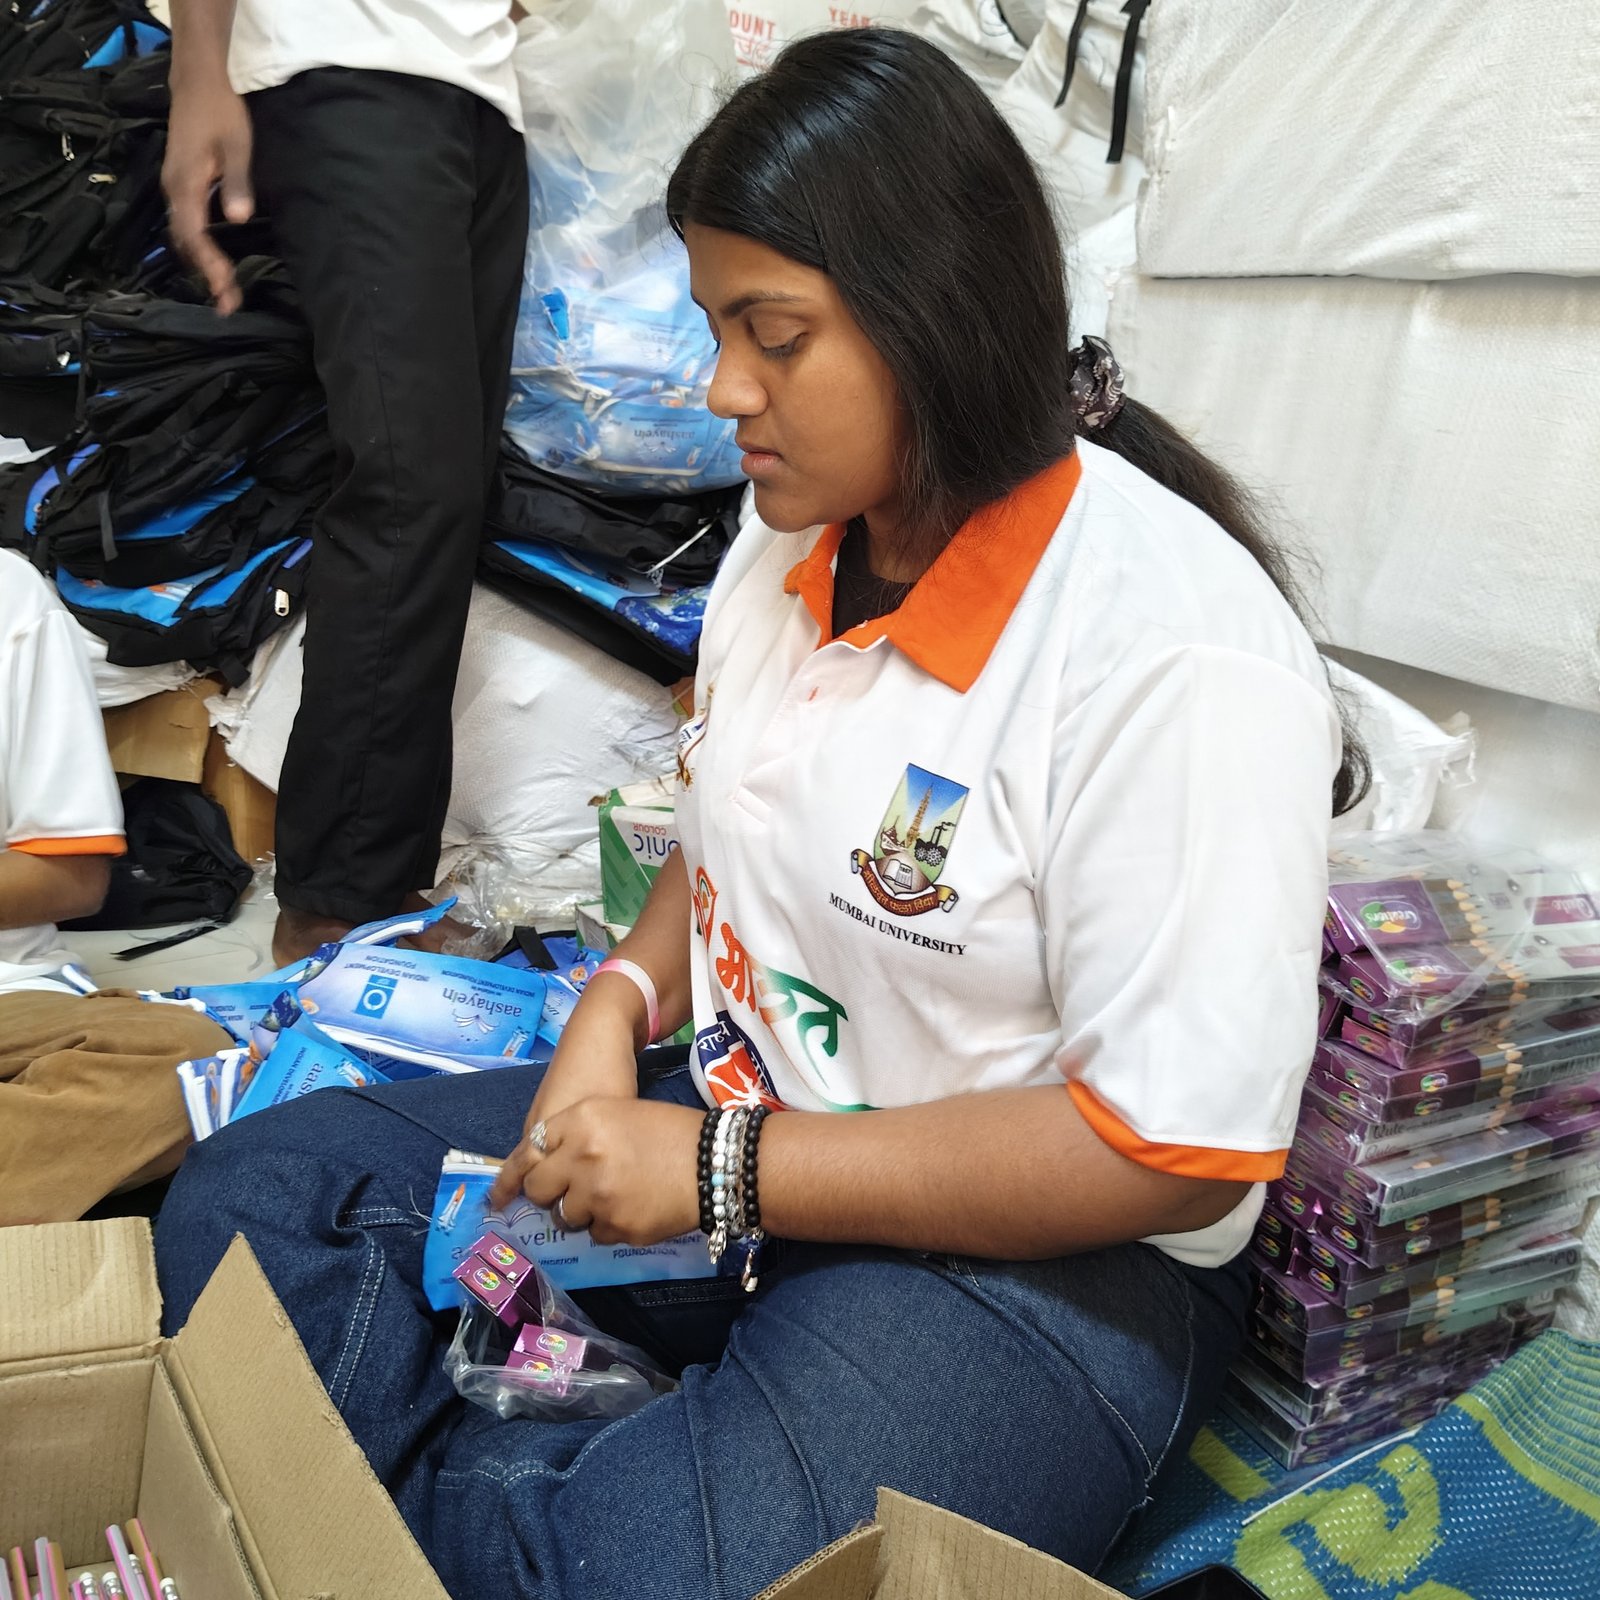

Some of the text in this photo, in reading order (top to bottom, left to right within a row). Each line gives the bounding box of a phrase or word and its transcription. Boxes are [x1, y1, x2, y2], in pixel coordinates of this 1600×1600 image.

[632, 822, 667, 836] COLOUR
[828, 891, 967, 956] MUMBAI UNIVERSITY
[344, 962, 401, 977] DEVELOPMENT
[365, 955, 417, 970] FOUNDATION
[402, 971, 430, 982] INDIAN
[477, 978, 516, 994] DEVELOPMENT
[515, 988, 536, 998] INDIAN
[442, 987, 522, 1018] aashayein
[612, 1247, 678, 1259] FOUNDATION
